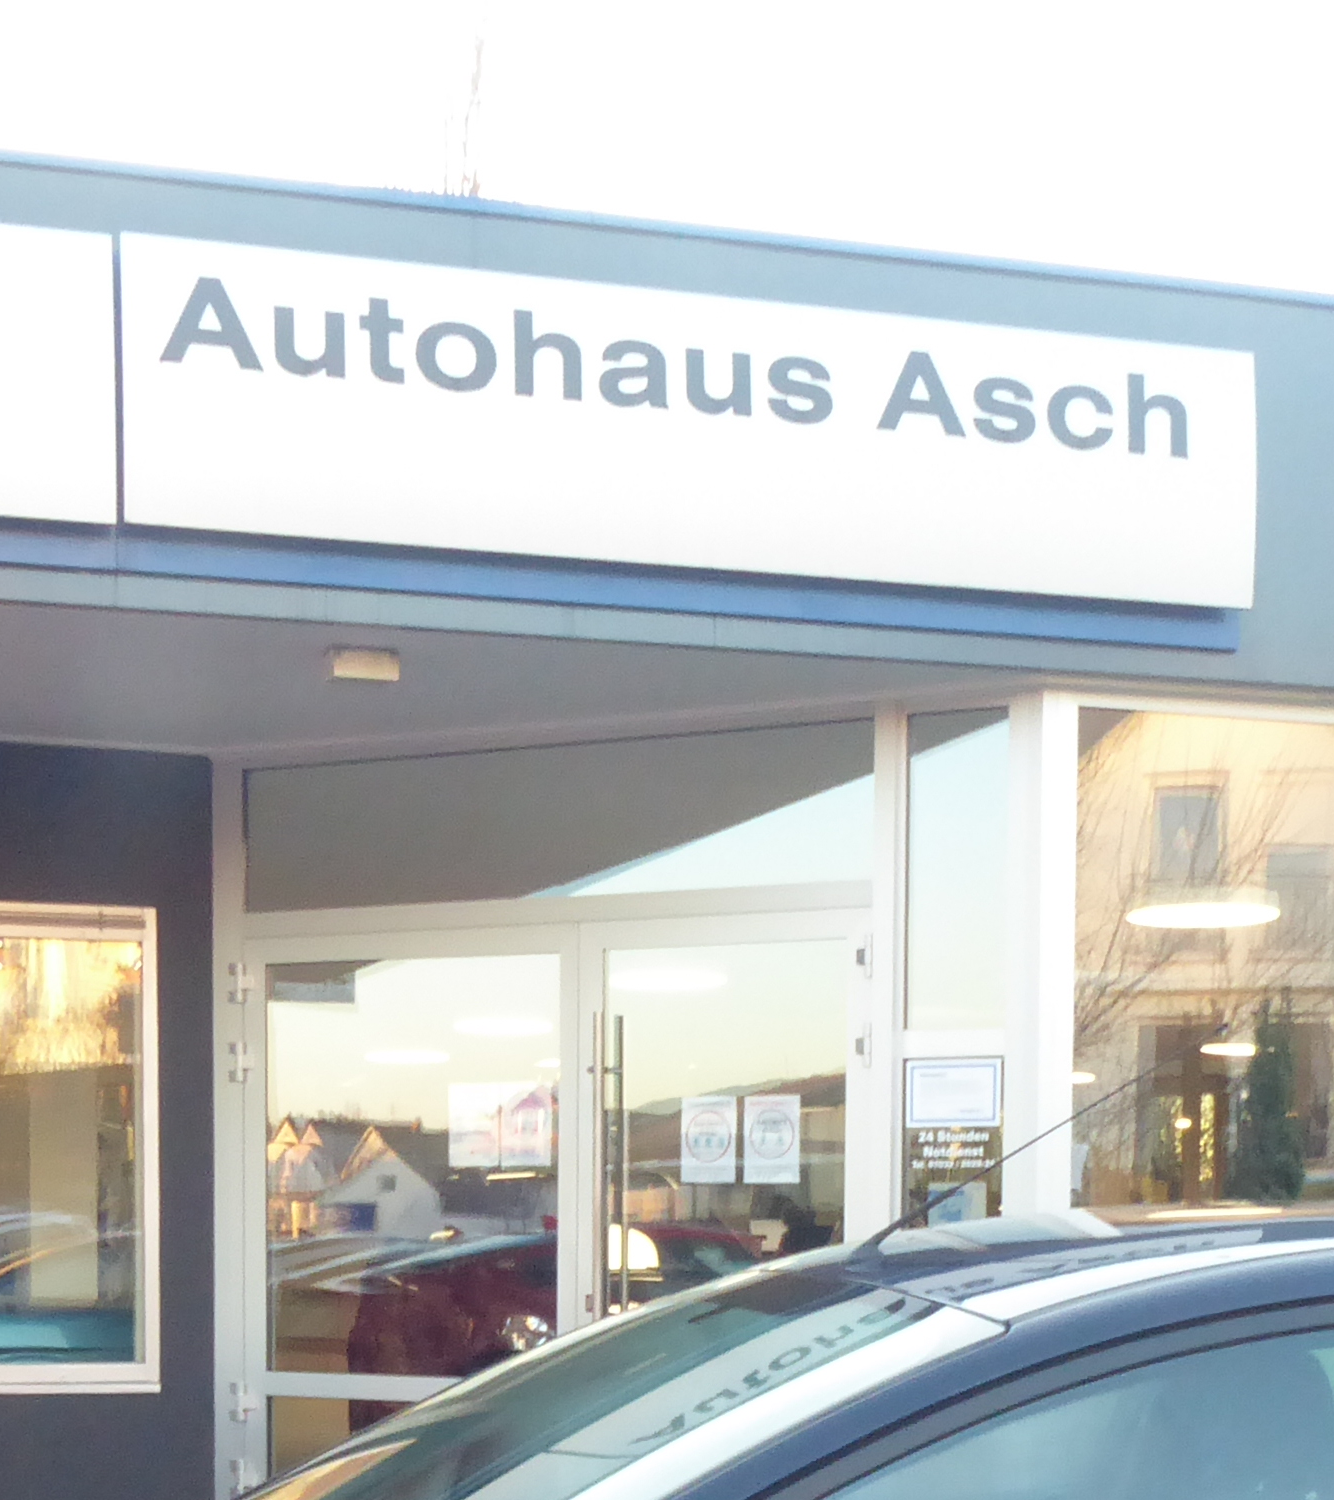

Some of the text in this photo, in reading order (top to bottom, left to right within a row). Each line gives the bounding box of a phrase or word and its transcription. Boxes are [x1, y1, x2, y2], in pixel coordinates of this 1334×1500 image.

[159, 276, 1188, 459] Autohaus Asch
[917, 1129, 990, 1143] 24 Stunden
[923, 1145, 984, 1158] Notdienst
